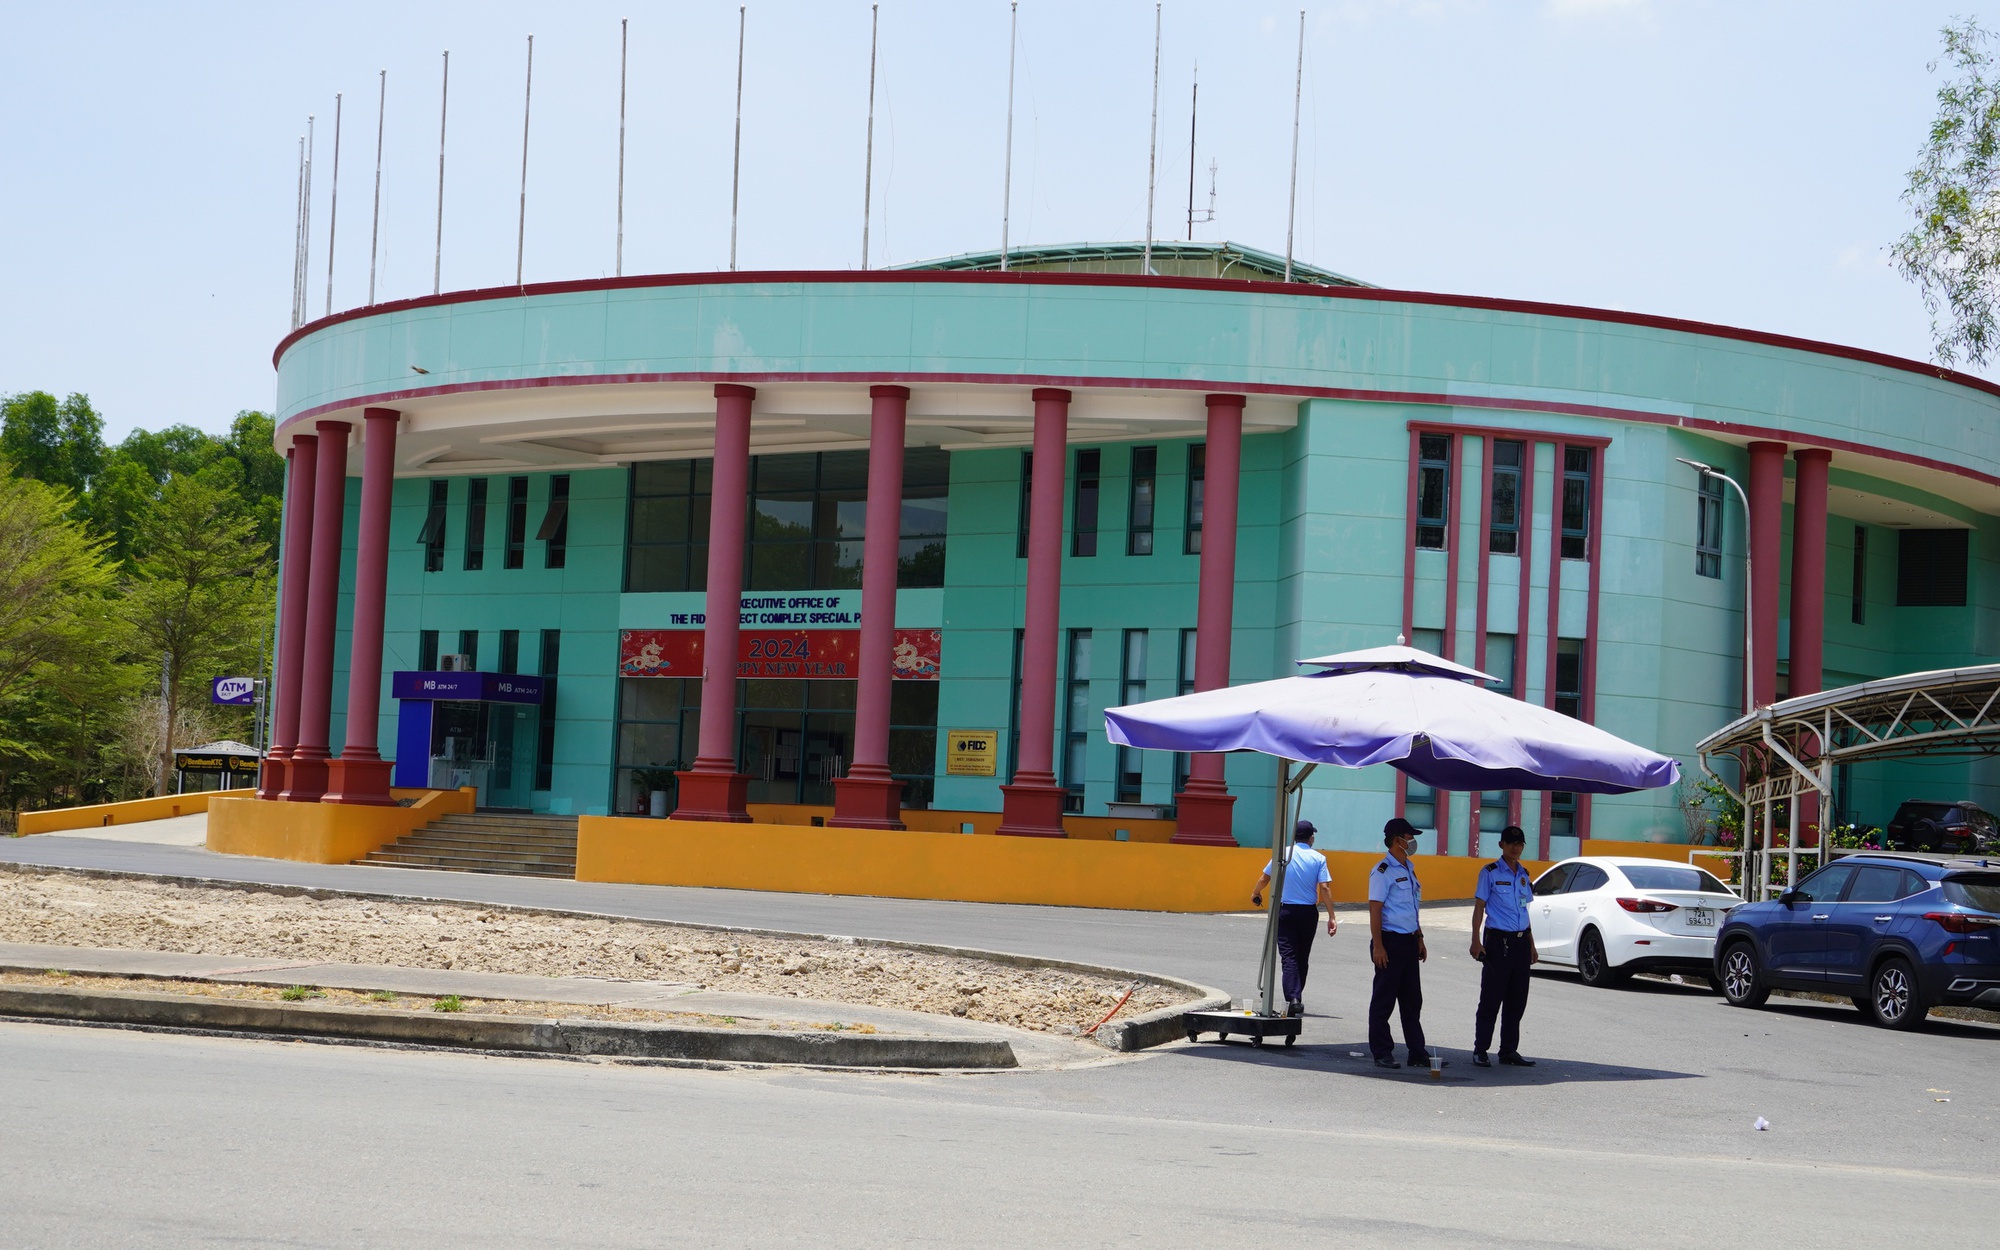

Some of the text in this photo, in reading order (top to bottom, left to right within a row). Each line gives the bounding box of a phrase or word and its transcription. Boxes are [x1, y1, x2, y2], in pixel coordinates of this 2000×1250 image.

[741, 597, 840, 608] XECUTIVE OFFICE OF
[670, 614, 688, 624] THE
[691, 614, 706, 624] FID
[760, 613, 807, 624] COMPLEX
[809, 612, 852, 624] SPECIAL
[749, 638, 811, 660] 2024
[764, 662, 800, 675] NEW
[804, 661, 846, 676] YEAR
[221, 682, 246, 692] ATM
[424, 681, 436, 690] MB
[498, 682, 513, 693] MB
[967, 741, 986, 750] FIDC
